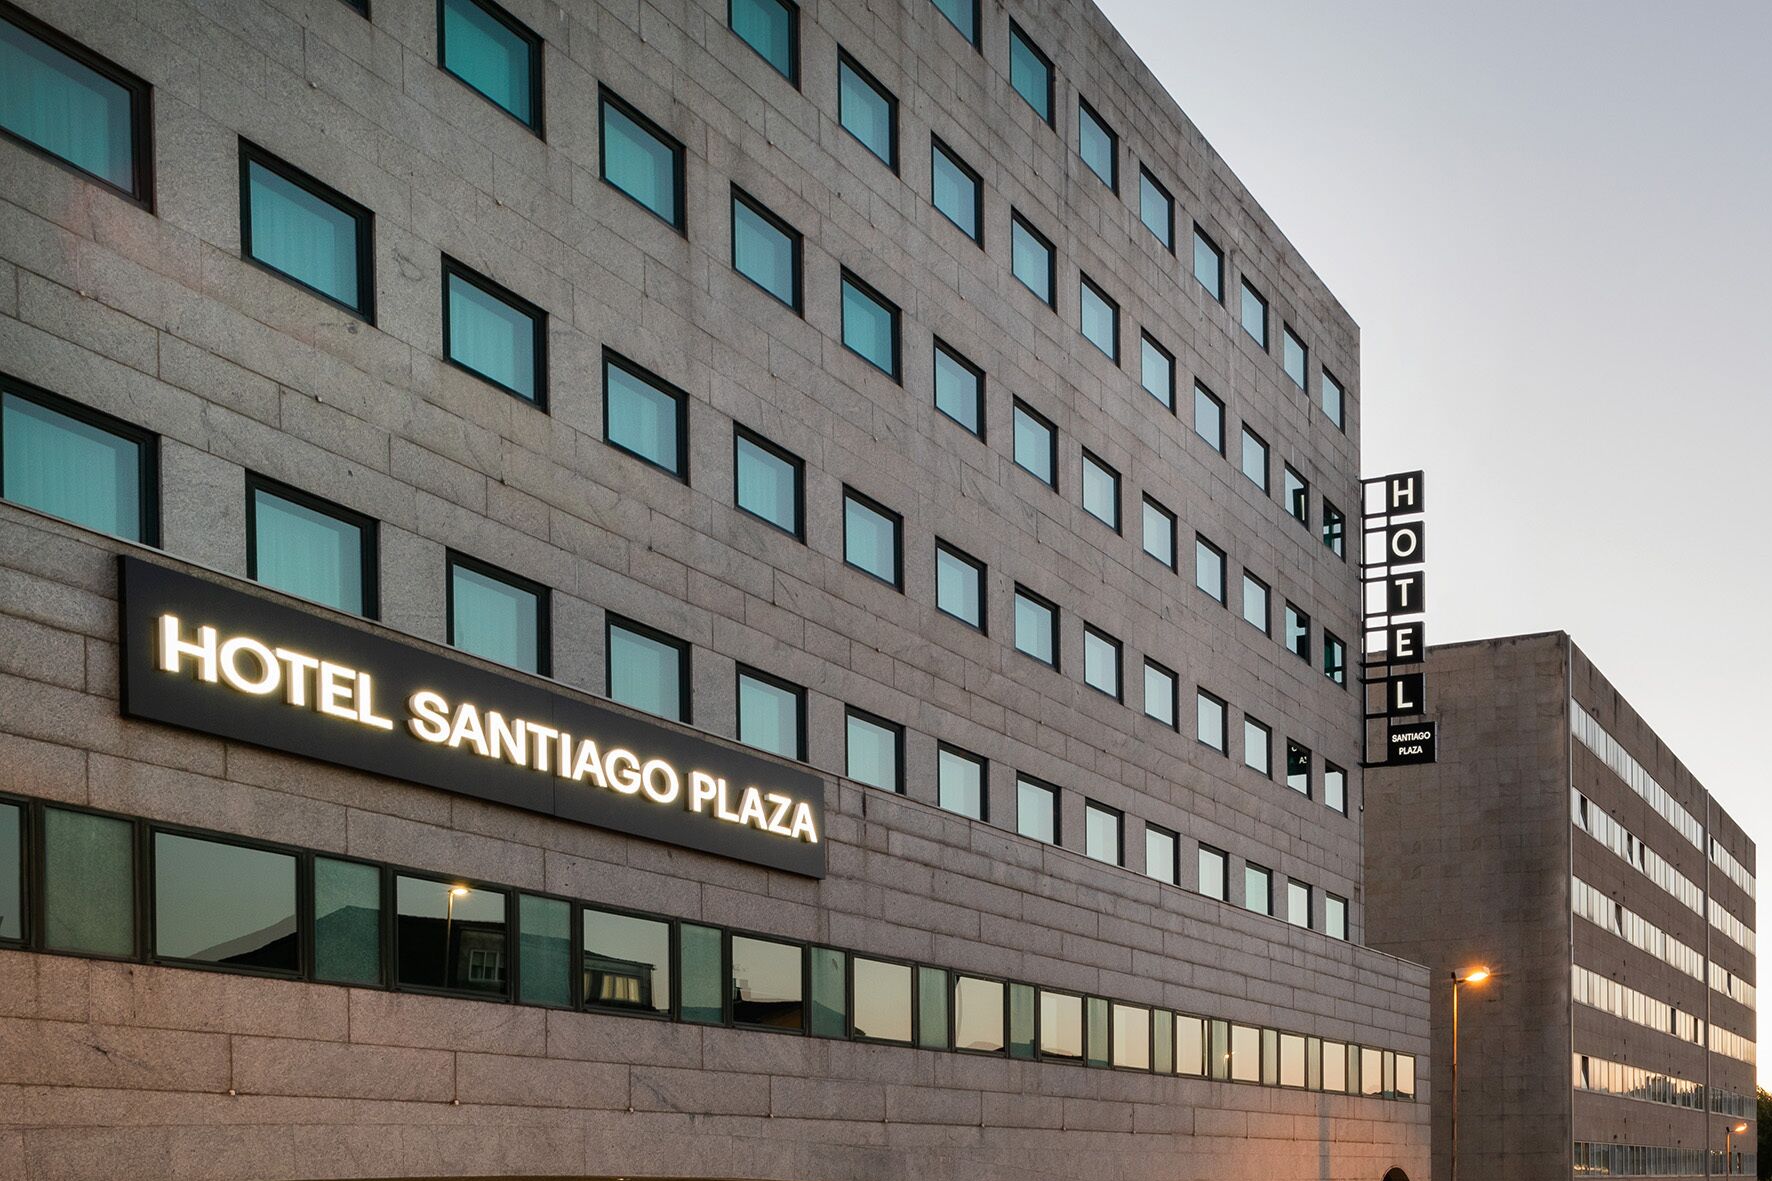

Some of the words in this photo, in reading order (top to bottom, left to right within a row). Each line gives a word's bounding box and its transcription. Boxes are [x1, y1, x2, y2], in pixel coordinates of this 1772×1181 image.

[1392, 477, 1417, 709] HOTEL
[158, 614, 394, 731] HOTEL
[407, 691, 680, 804] SANTIAGO
[688, 770, 818, 844] PLAZA
[1391, 731, 1431, 743] SANTIAGO
[1398, 745, 1423, 756] PLAZA
